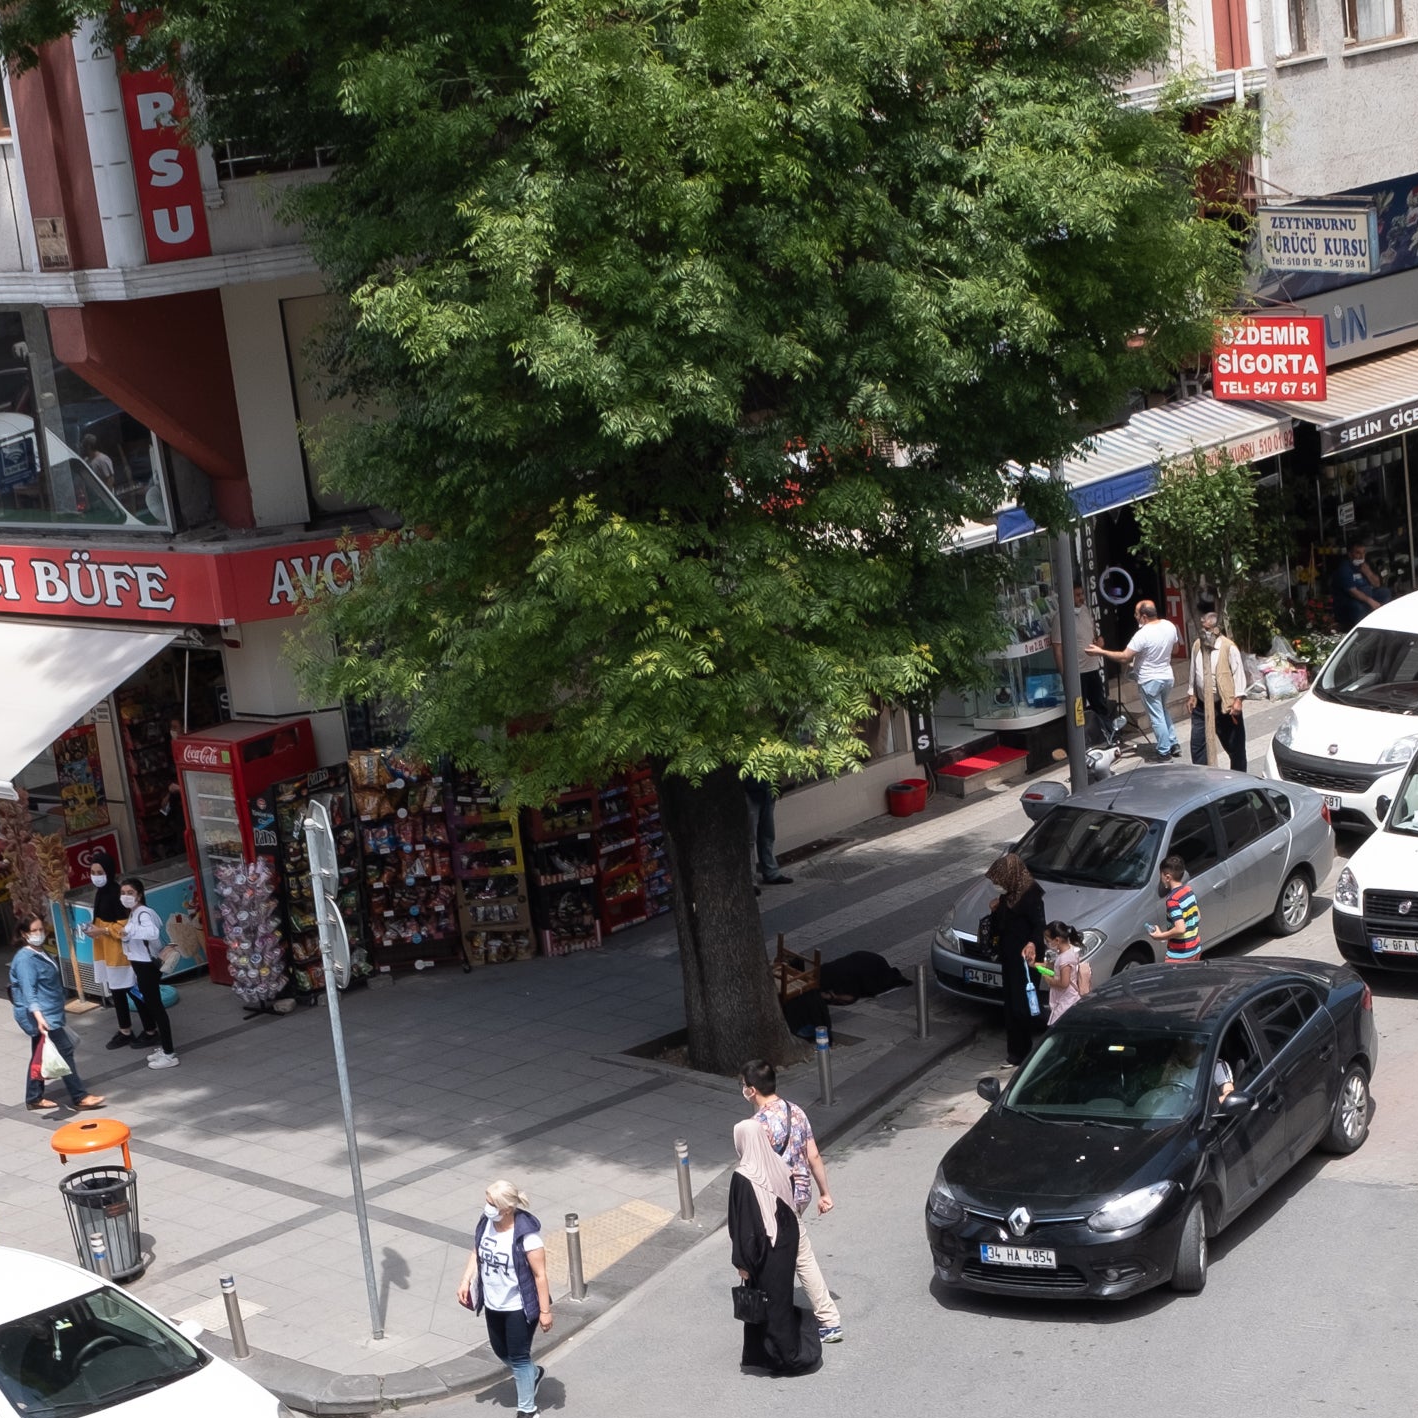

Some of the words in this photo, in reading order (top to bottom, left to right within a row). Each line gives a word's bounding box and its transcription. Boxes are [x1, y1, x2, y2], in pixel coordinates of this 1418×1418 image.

[1324, 238, 1369, 258] KURSU
[1287, 257, 1301, 268] 510
[1303, 258, 1312, 268] 01
[1313, 258, 1322, 268] 92
[1329, 259, 1344, 269] 547
[1345, 260, 1356, 269] 59
[1357, 260, 1367, 270] 14
[1323, 303, 1369, 350] LİN
[1217, 349, 1320, 376] SİGORTA
[1220, 381, 1251, 395] TEL:
[1253, 381, 1278, 395] 547
[1280, 381, 1298, 394] 67
[1301, 380, 1318, 394] 51
[1258, 437, 1272, 455] 510
[1283, 430, 1295, 448] 92
[1340, 419, 1383, 444] SELİN
[1084, 524, 1096, 571] hone
[29, 549, 177, 612] BÜFE
[981, 971, 999, 986] BPL
[987, 1246, 1001, 1261] 34
[1006, 1248, 1021, 1263] HA
[1026, 1250, 1054, 1264] 4854
